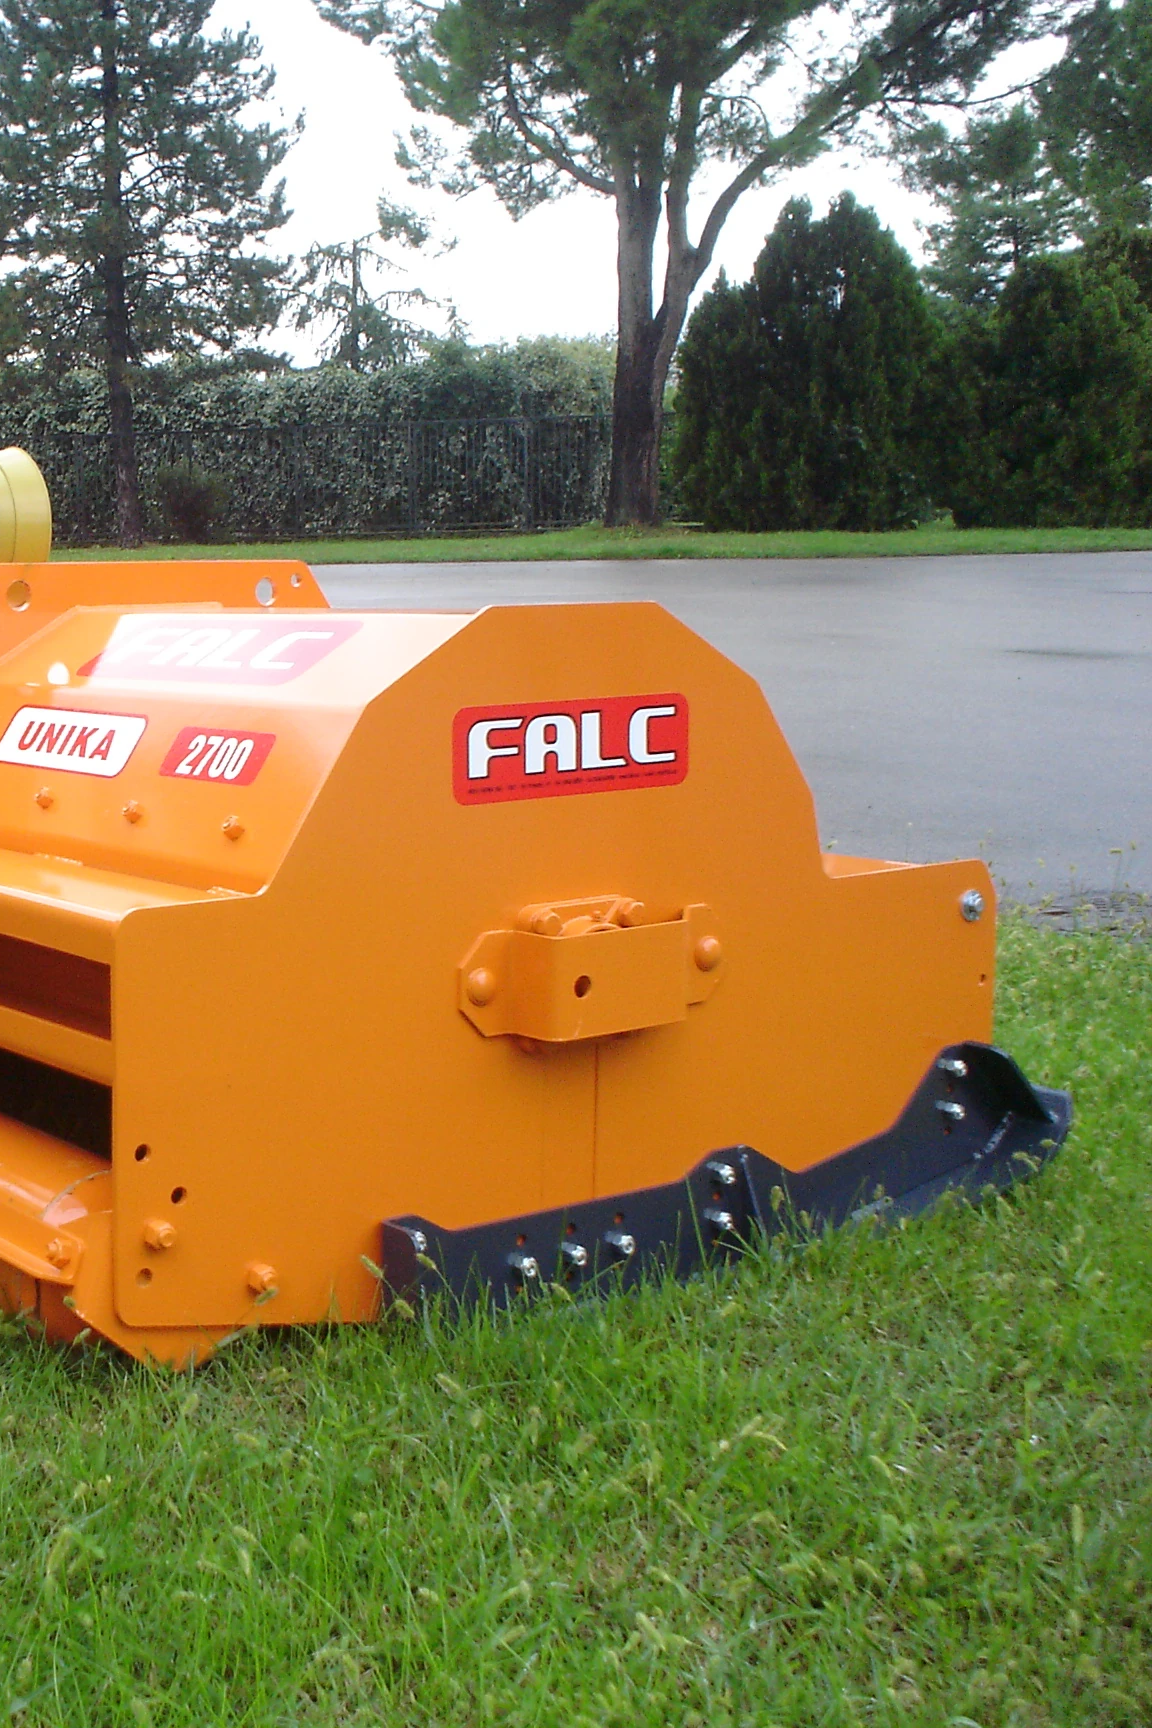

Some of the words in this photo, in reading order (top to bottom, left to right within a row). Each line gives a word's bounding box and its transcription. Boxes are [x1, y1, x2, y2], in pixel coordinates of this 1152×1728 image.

[104, 627, 336, 670] FALC
[17, 720, 117, 761] UNIKA
[174, 734, 255, 780] 2700
[467, 705, 677, 780] FALC
